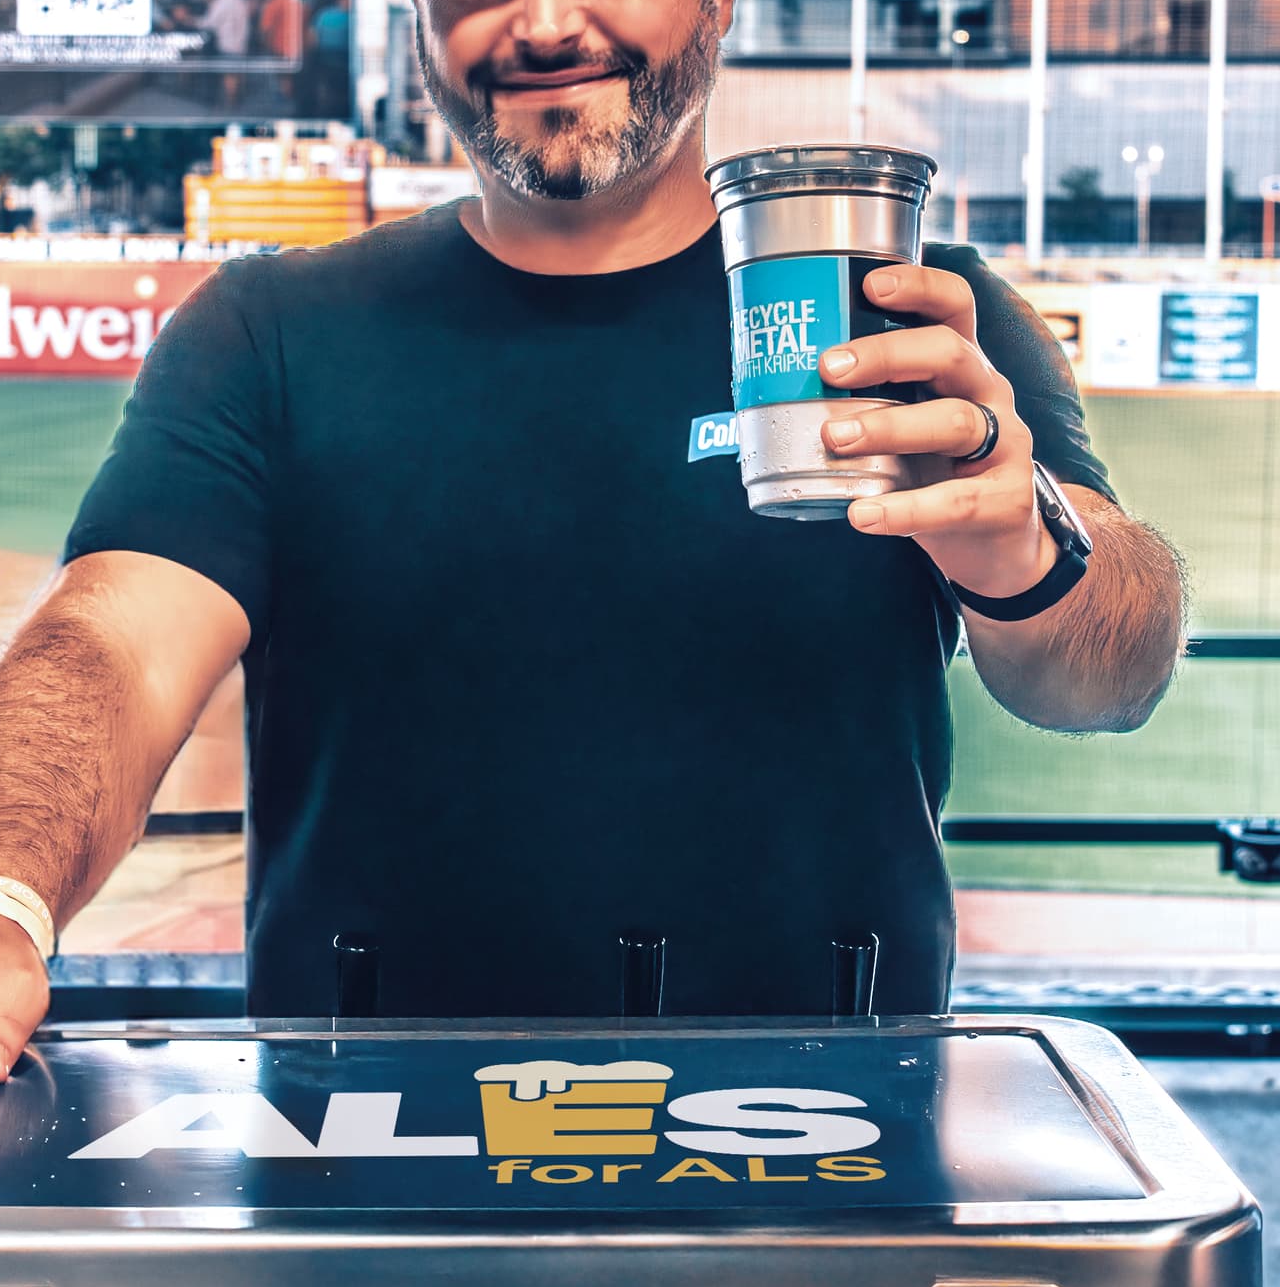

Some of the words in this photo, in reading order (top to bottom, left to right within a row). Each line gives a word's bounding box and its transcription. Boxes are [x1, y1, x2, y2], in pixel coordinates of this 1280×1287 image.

[764, 350, 818, 376] KRIPKE
[67, 1082, 882, 1161] ALES
[488, 1158, 644, 1184] for
[656, 1156, 887, 1184] ALS
